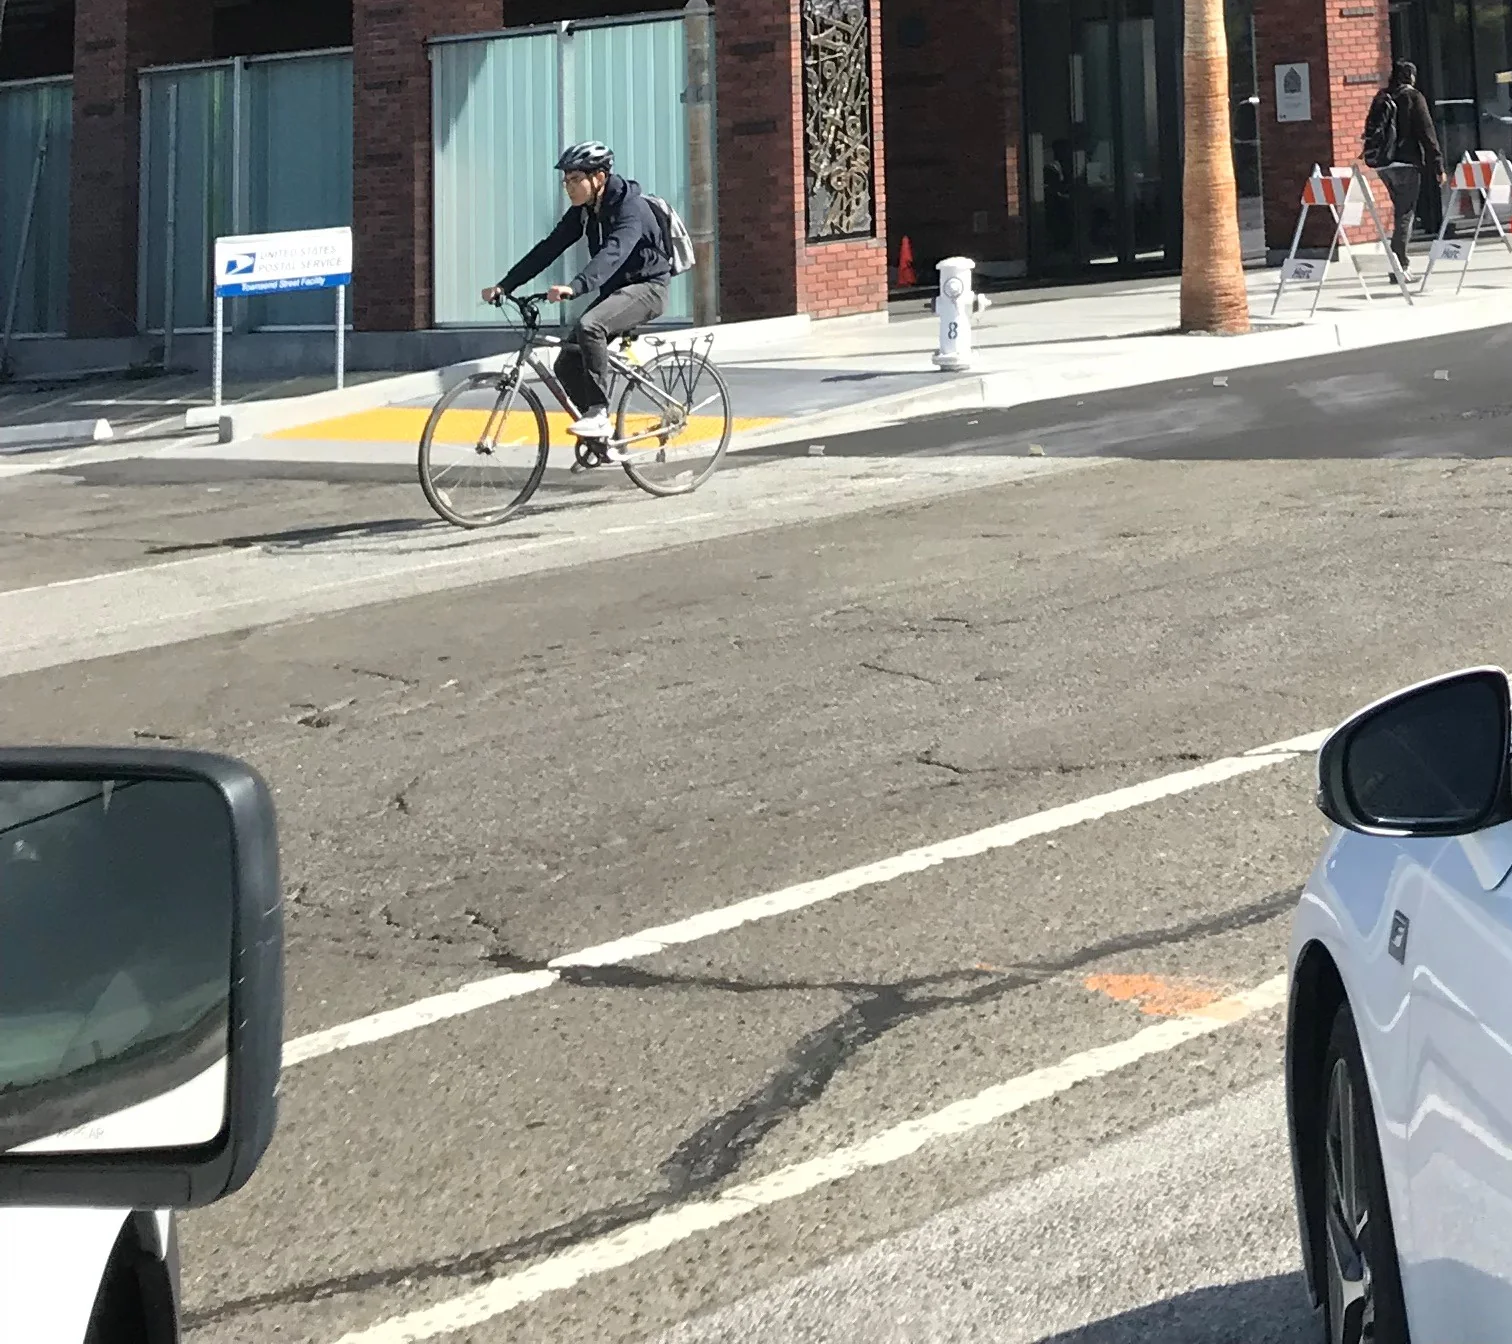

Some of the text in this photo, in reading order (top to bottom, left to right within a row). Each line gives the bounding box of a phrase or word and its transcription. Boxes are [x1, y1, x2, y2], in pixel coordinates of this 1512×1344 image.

[260, 245, 337, 260] UNITED STATES
[258, 257, 343, 272] POSTAL SERVICE
[279, 279, 300, 289] Street
[947, 321, 959, 340] 8
